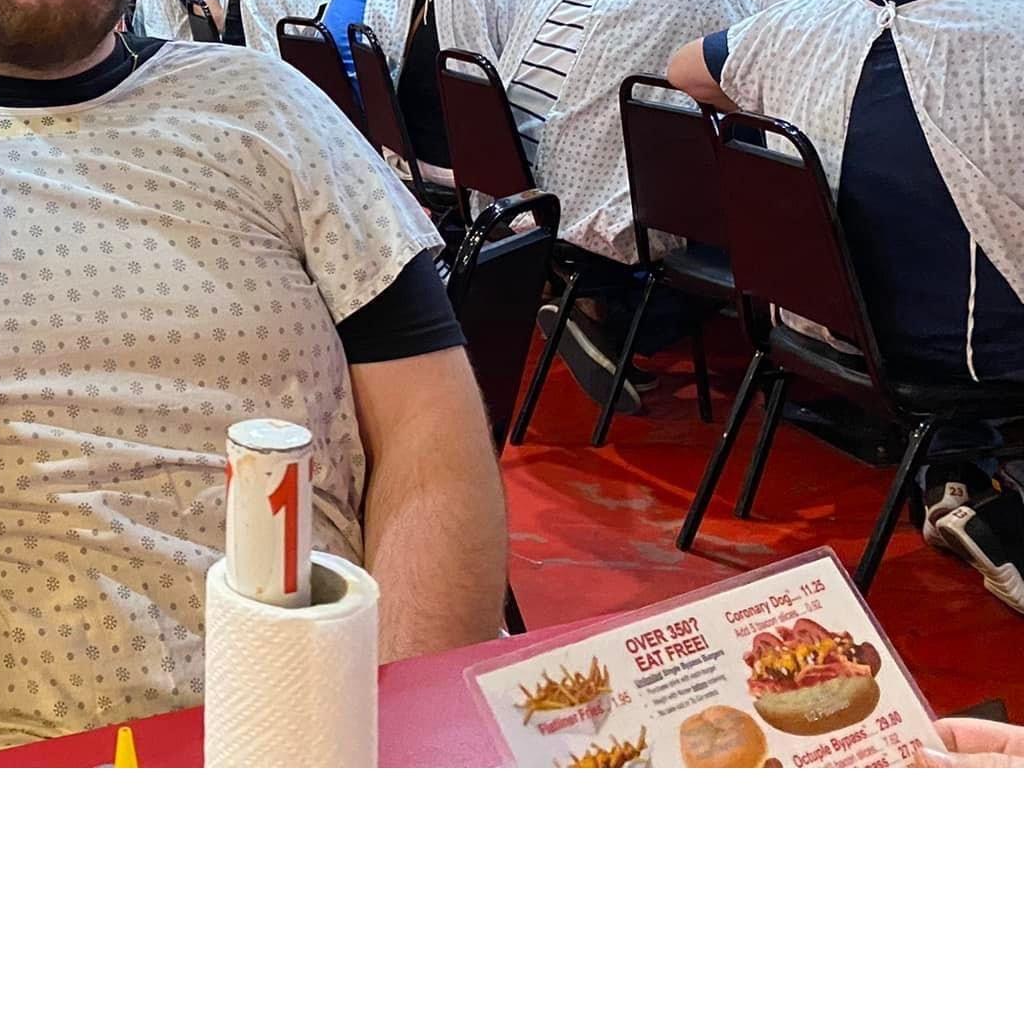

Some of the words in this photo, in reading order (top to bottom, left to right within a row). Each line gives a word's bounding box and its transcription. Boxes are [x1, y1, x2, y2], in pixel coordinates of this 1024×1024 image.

[949, 487, 964, 497] 23
[268, 462, 298, 594] 1
[952, 509, 968, 519] 23
[725, 601, 771, 624] Coronary
[801, 579, 825, 596] 11.25
[625, 628, 668, 654] OVER
[666, 617, 699, 640] 350?
[635, 650, 664, 673] EAT
[665, 634, 709, 661] FREE!
[793, 744, 832, 768] Octuple
[830, 729, 868, 751] Bypass
